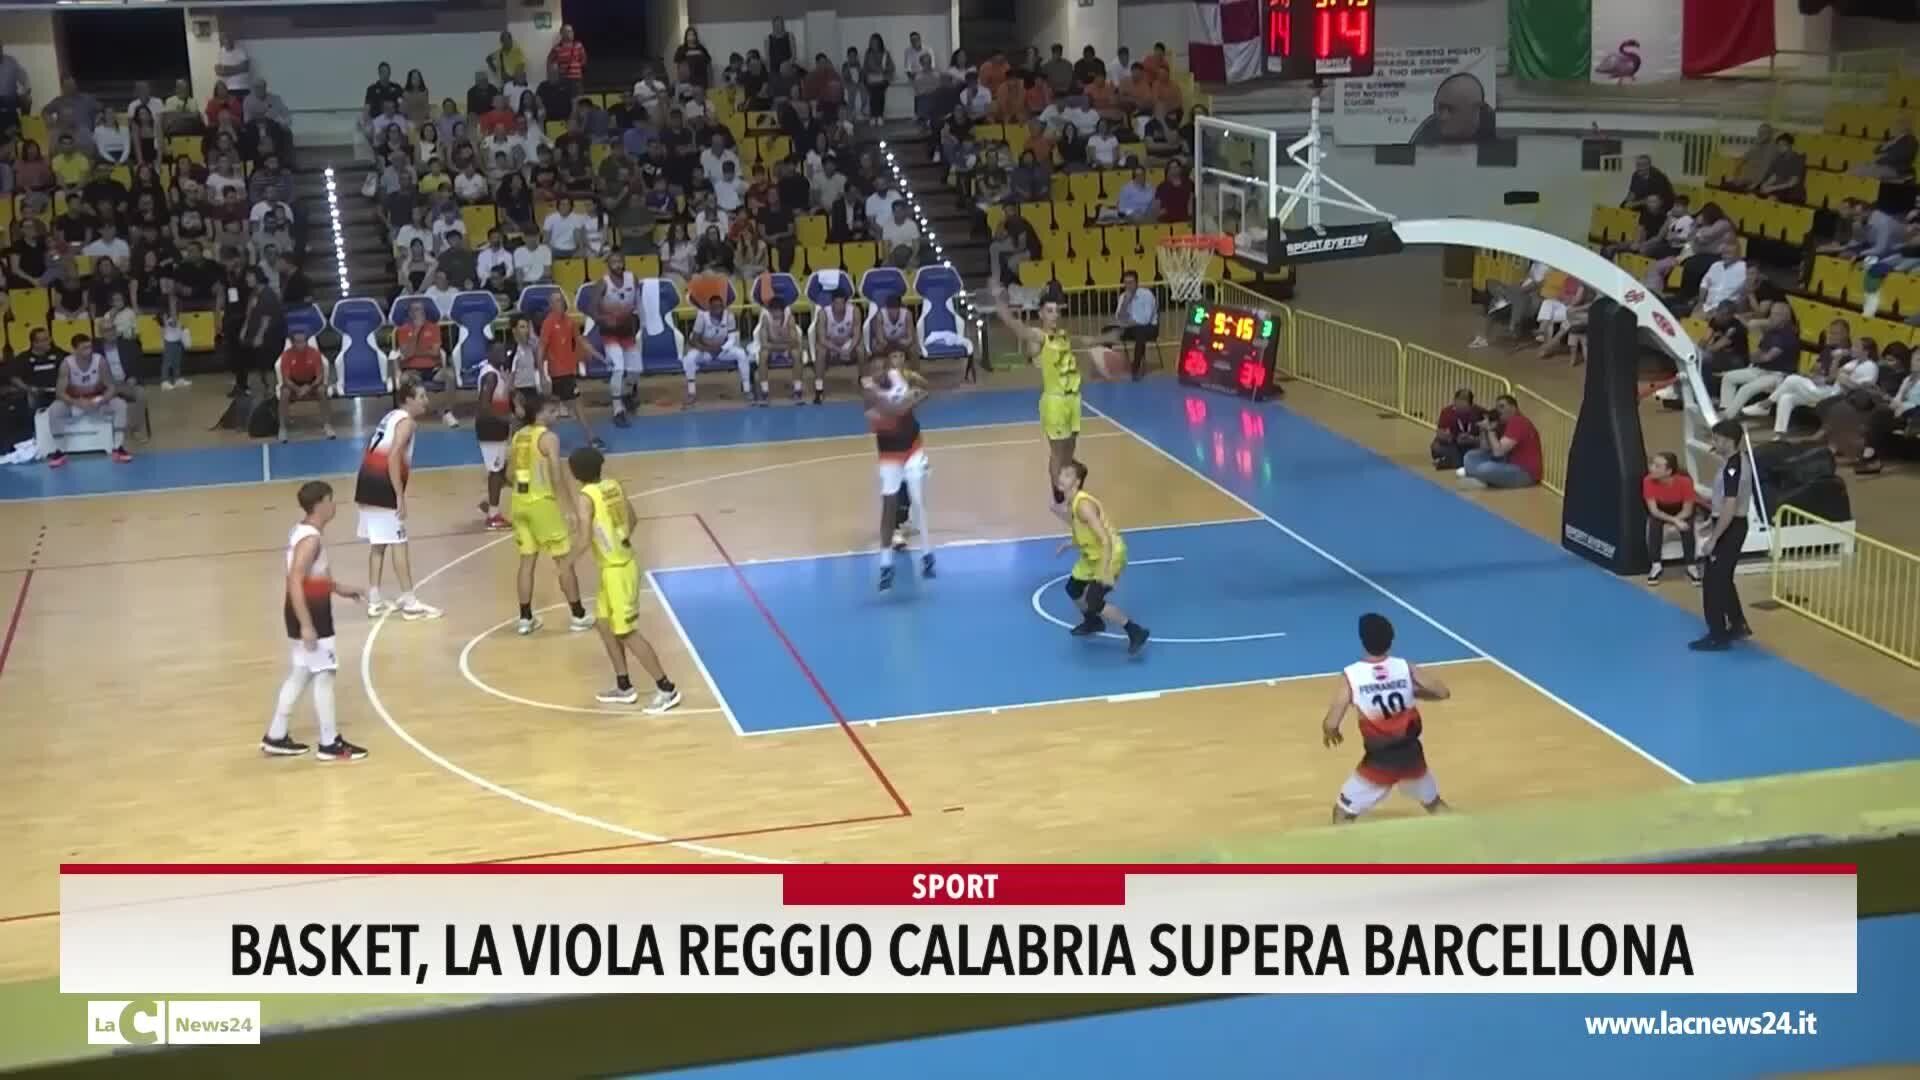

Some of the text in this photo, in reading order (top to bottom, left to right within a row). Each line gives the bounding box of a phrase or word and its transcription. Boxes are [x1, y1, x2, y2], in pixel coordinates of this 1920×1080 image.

[1320, 10, 1368, 57] 14
[1213, 311, 1255, 341] 5:15
[1371, 691, 1405, 720] 10
